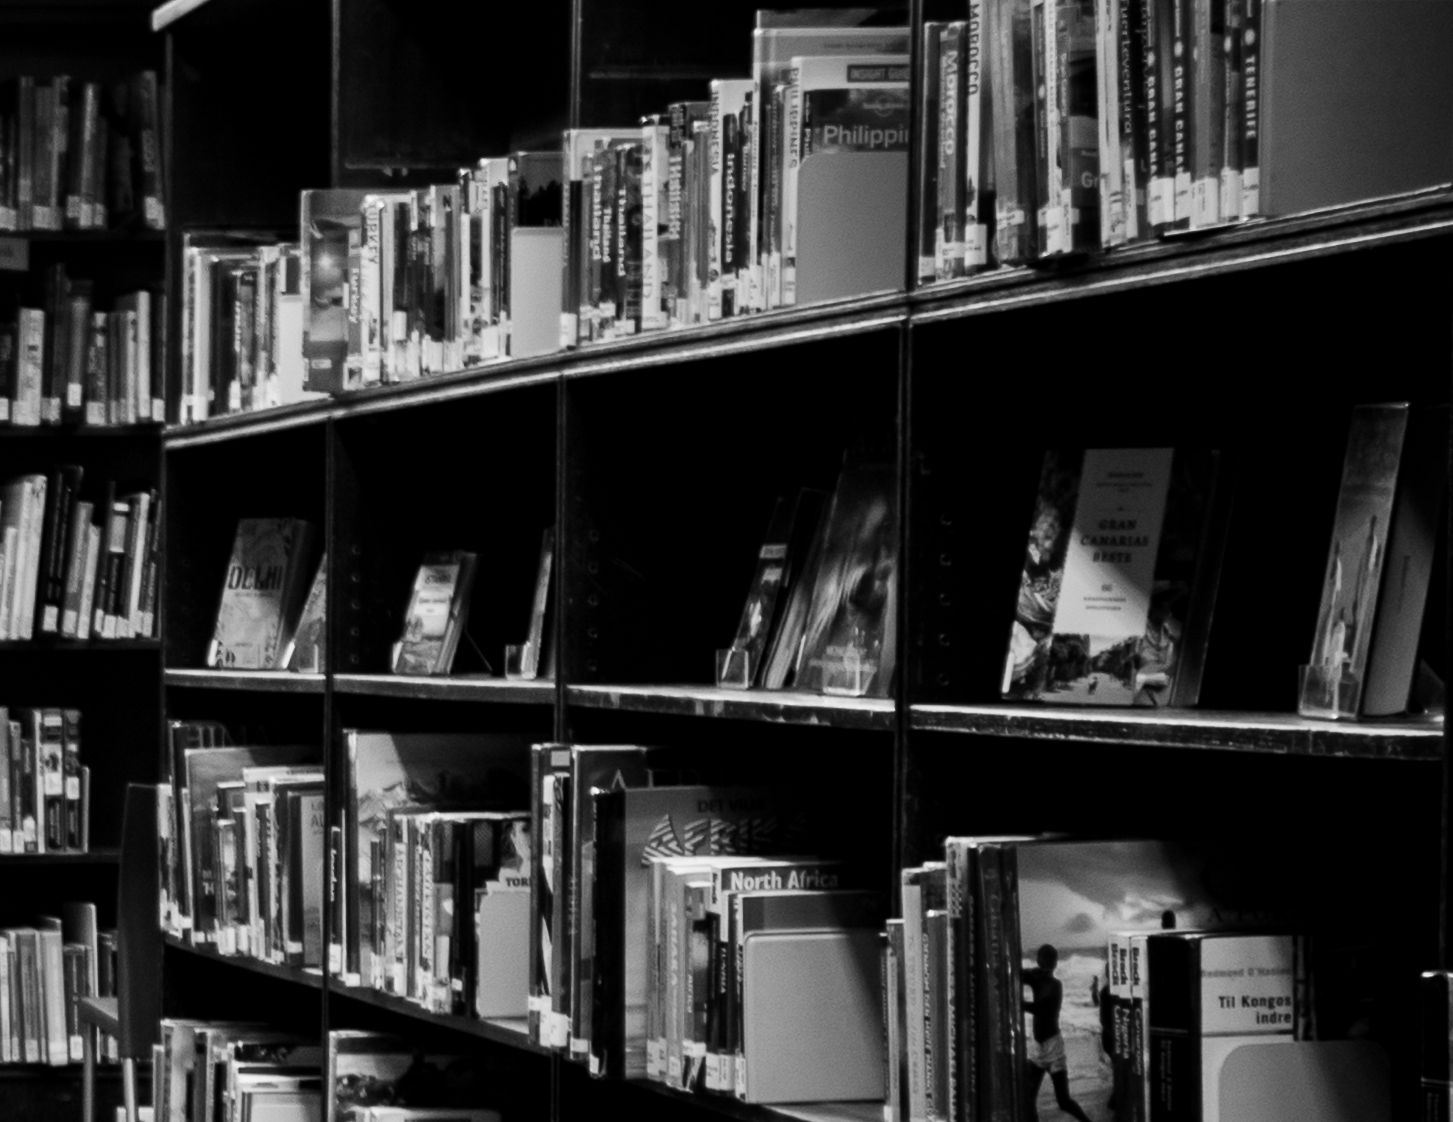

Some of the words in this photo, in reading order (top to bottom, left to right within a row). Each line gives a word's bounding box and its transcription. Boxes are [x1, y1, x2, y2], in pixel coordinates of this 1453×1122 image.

[945, 51, 959, 155] Morocco
[1245, 55, 1257, 140] TENERIFE
[1149, 127, 1158, 178] CANA
[1176, 119, 1186, 172] CANA
[725, 153, 736, 263] Indonesia
[1098, 519, 1137, 531] GRAN
[729, 869, 783, 891] North
[787, 869, 840, 891] Africa
[1218, 996, 1236, 1009] Til
[1241, 995, 1292, 1010] Kongos
[1256, 1011, 1292, 1025] indre
